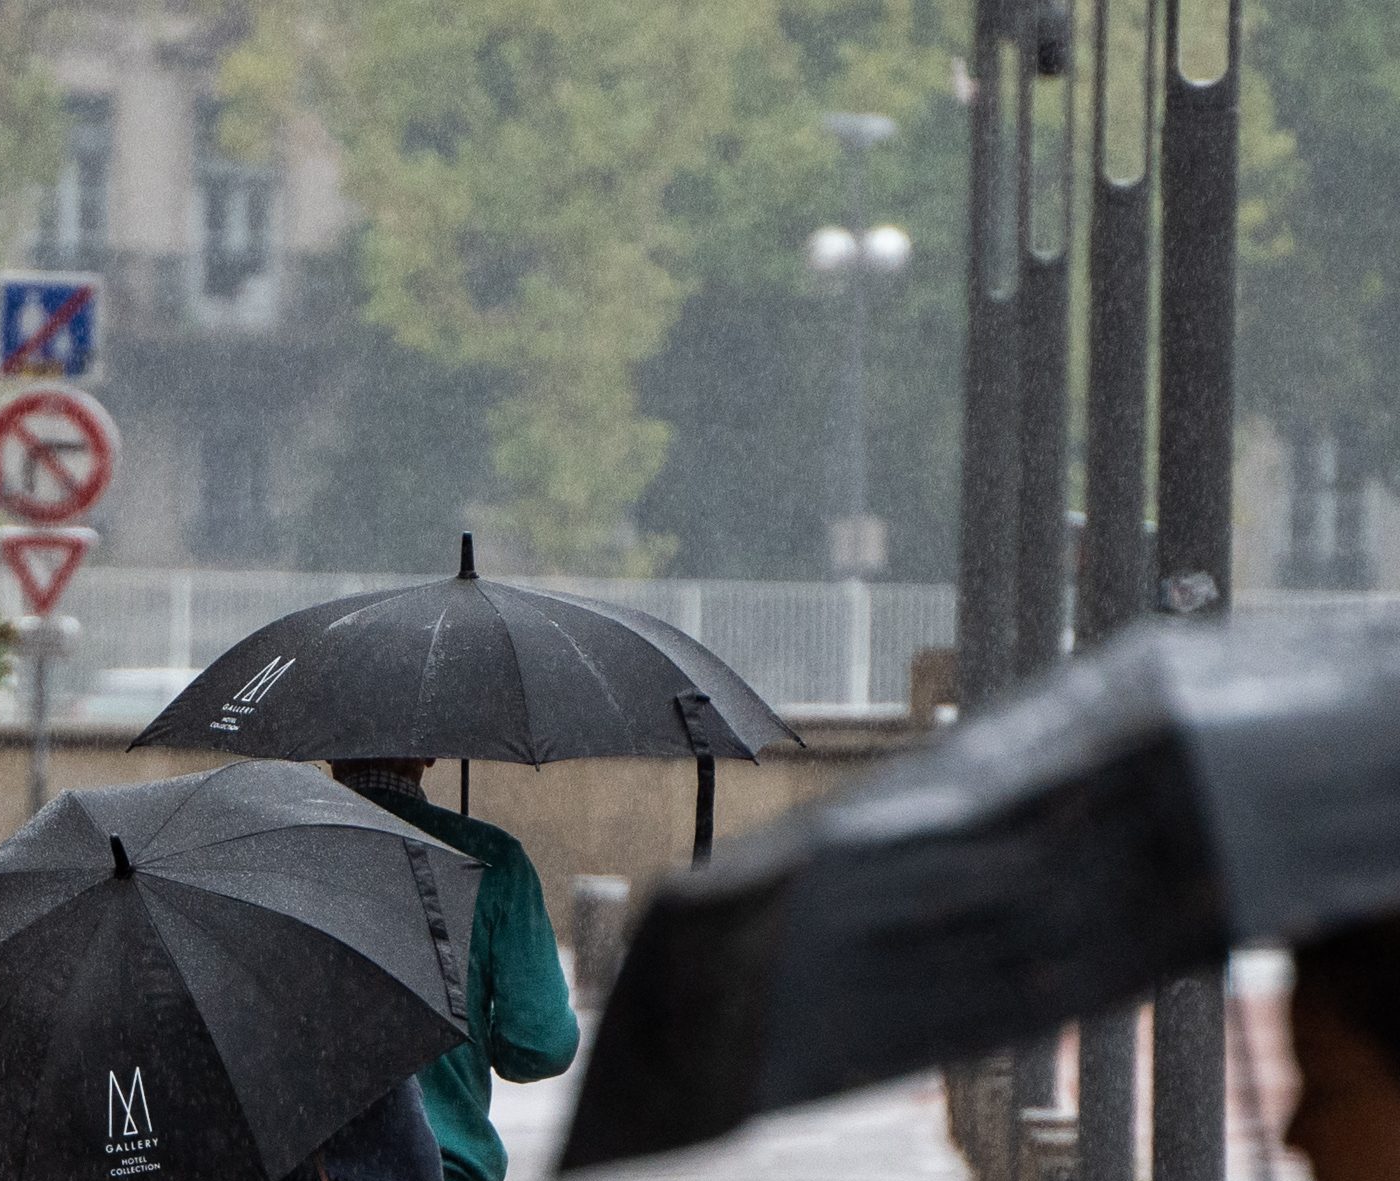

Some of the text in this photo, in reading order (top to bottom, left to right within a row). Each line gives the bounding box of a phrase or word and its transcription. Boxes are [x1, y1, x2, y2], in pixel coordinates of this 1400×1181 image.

[222, 703, 255, 714] GALLERY
[105, 1138, 159, 1153] GALLERY
[121, 1156, 147, 1166] HOTEL
[110, 1163, 161, 1177] COLLECTION
